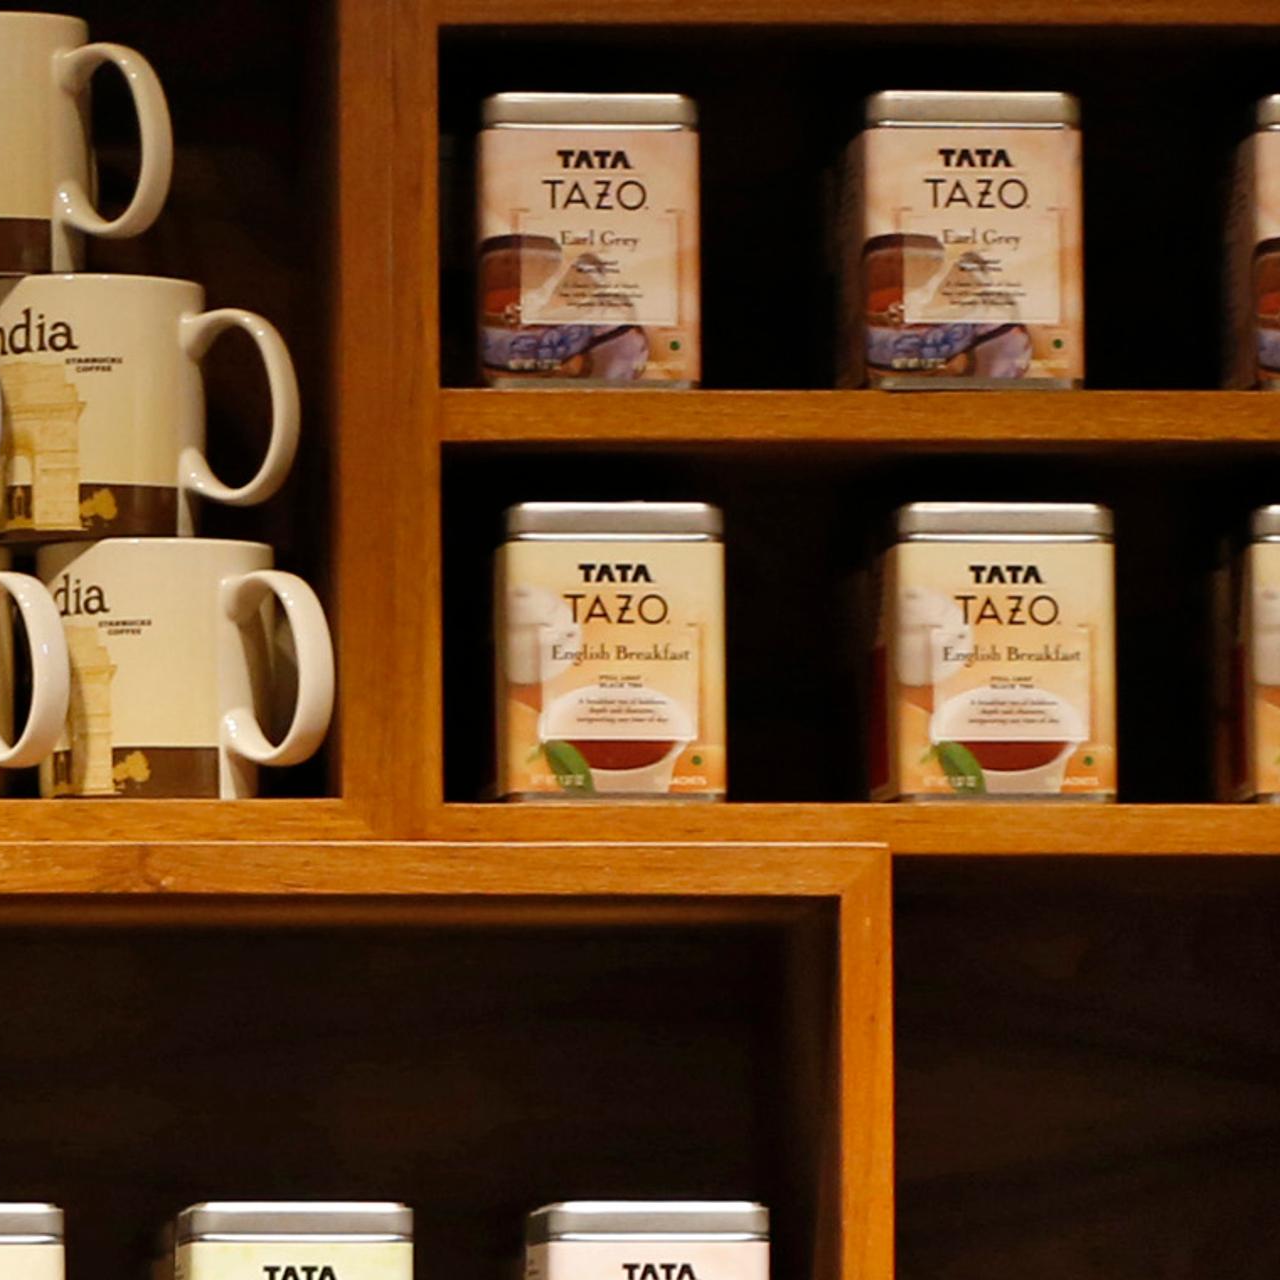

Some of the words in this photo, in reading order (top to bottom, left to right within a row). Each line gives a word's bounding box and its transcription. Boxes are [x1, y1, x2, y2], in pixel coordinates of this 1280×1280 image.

[557, 150, 632, 169] TATA
[938, 149, 1013, 167] TATA
[542, 180, 647, 211] TAZO
[923, 178, 1028, 209] TAZO
[578, 564, 652, 582] TATA
[969, 565, 1043, 583] TATA
[52, 574, 110, 617] dia
[563, 594, 668, 624] TAZO
[954, 595, 1059, 625] TAZO
[551, 644, 610, 665] English
[615, 644, 690, 661] Breakfast
[942, 645, 1001, 667] English
[1007, 645, 1081, 662] Breakfast
